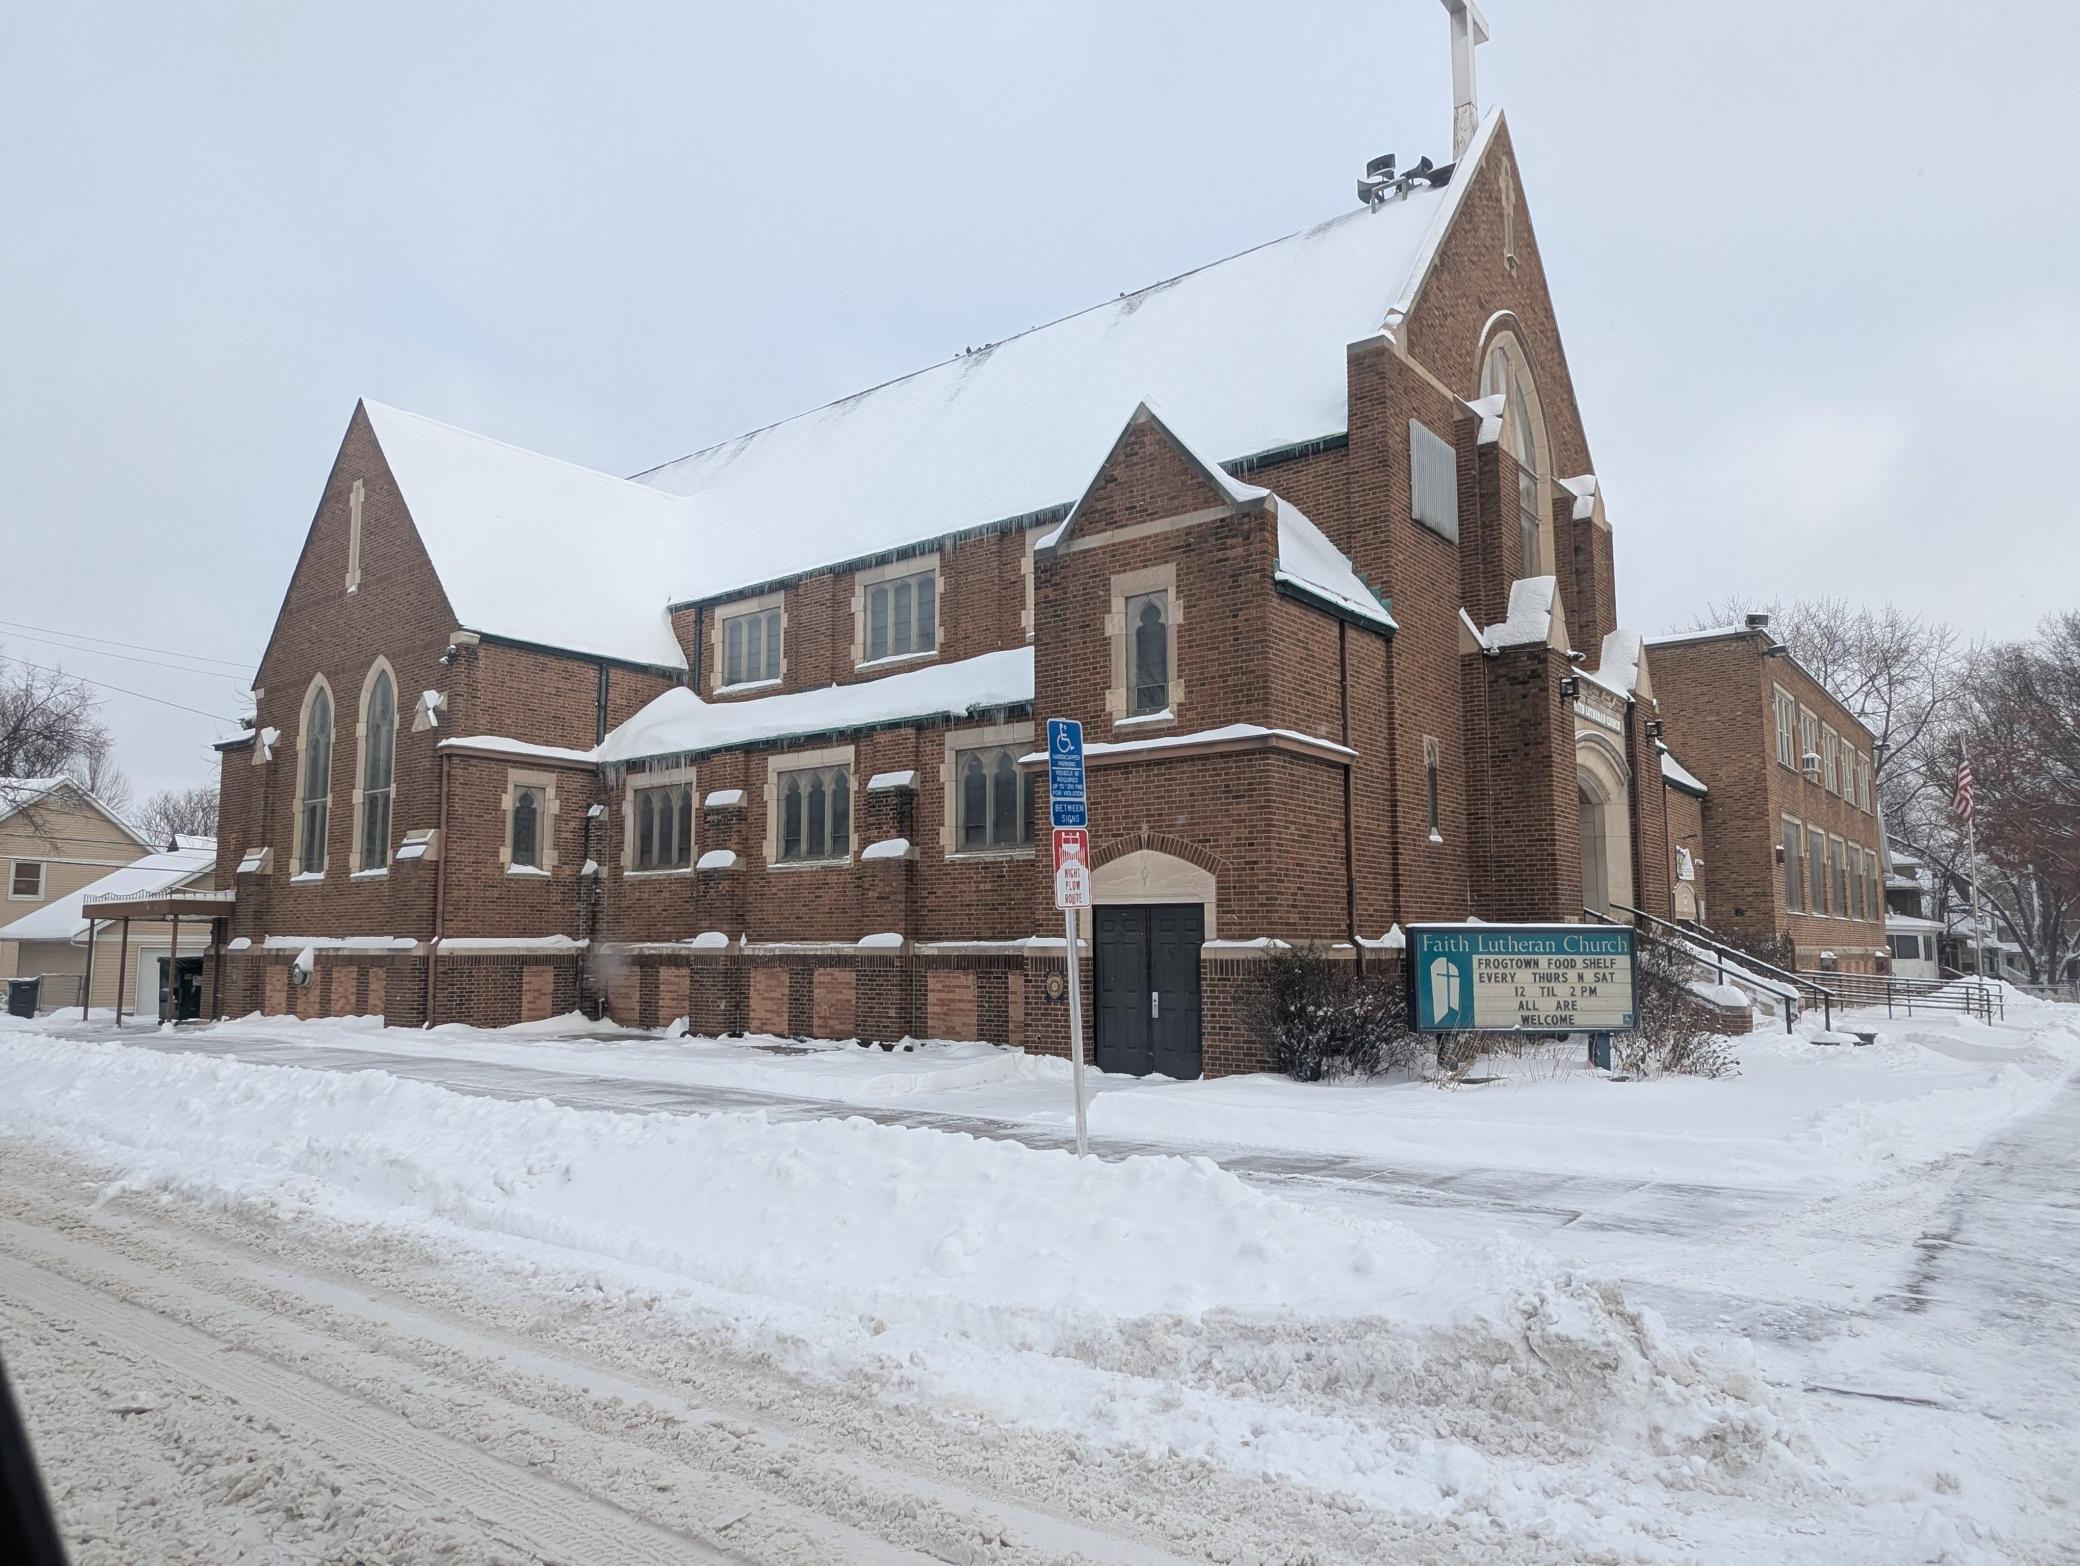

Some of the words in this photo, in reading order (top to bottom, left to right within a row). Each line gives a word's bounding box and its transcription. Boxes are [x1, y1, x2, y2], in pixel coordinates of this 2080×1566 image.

[1055, 804, 1084, 812] BETWEEN
[1061, 814, 1080, 823] SIGNS
[1064, 868, 1080, 878] NIGHT
[1065, 880, 1081, 891] PLOW
[1064, 893, 1082, 904] ROUTE
[1423, 935, 1469, 952] Faith
[1478, 935, 1556, 952] Lutheran
[1563, 935, 1628, 952] Church
[1478, 958, 1540, 969] FROGTOWN
[1547, 958, 1577, 969] FOOD
[1582, 958, 1616, 969] SHELF
[1479, 972, 1517, 983] EVERY
[1531, 972, 1568, 983] THURS
[1577, 972, 1584, 983] N
[1593, 972, 1616, 983] SAT
[1514, 986, 1526, 997] 12
[1539, 986, 1558, 997] TIL
[1570, 986, 1576, 997] 2
[1581, 986, 1598, 997] PM
[1517, 1000, 1539, 1011] ALL
[1555, 1000, 1578, 1011] ARE
[1520, 1014, 1575, 1025] WELCOME
